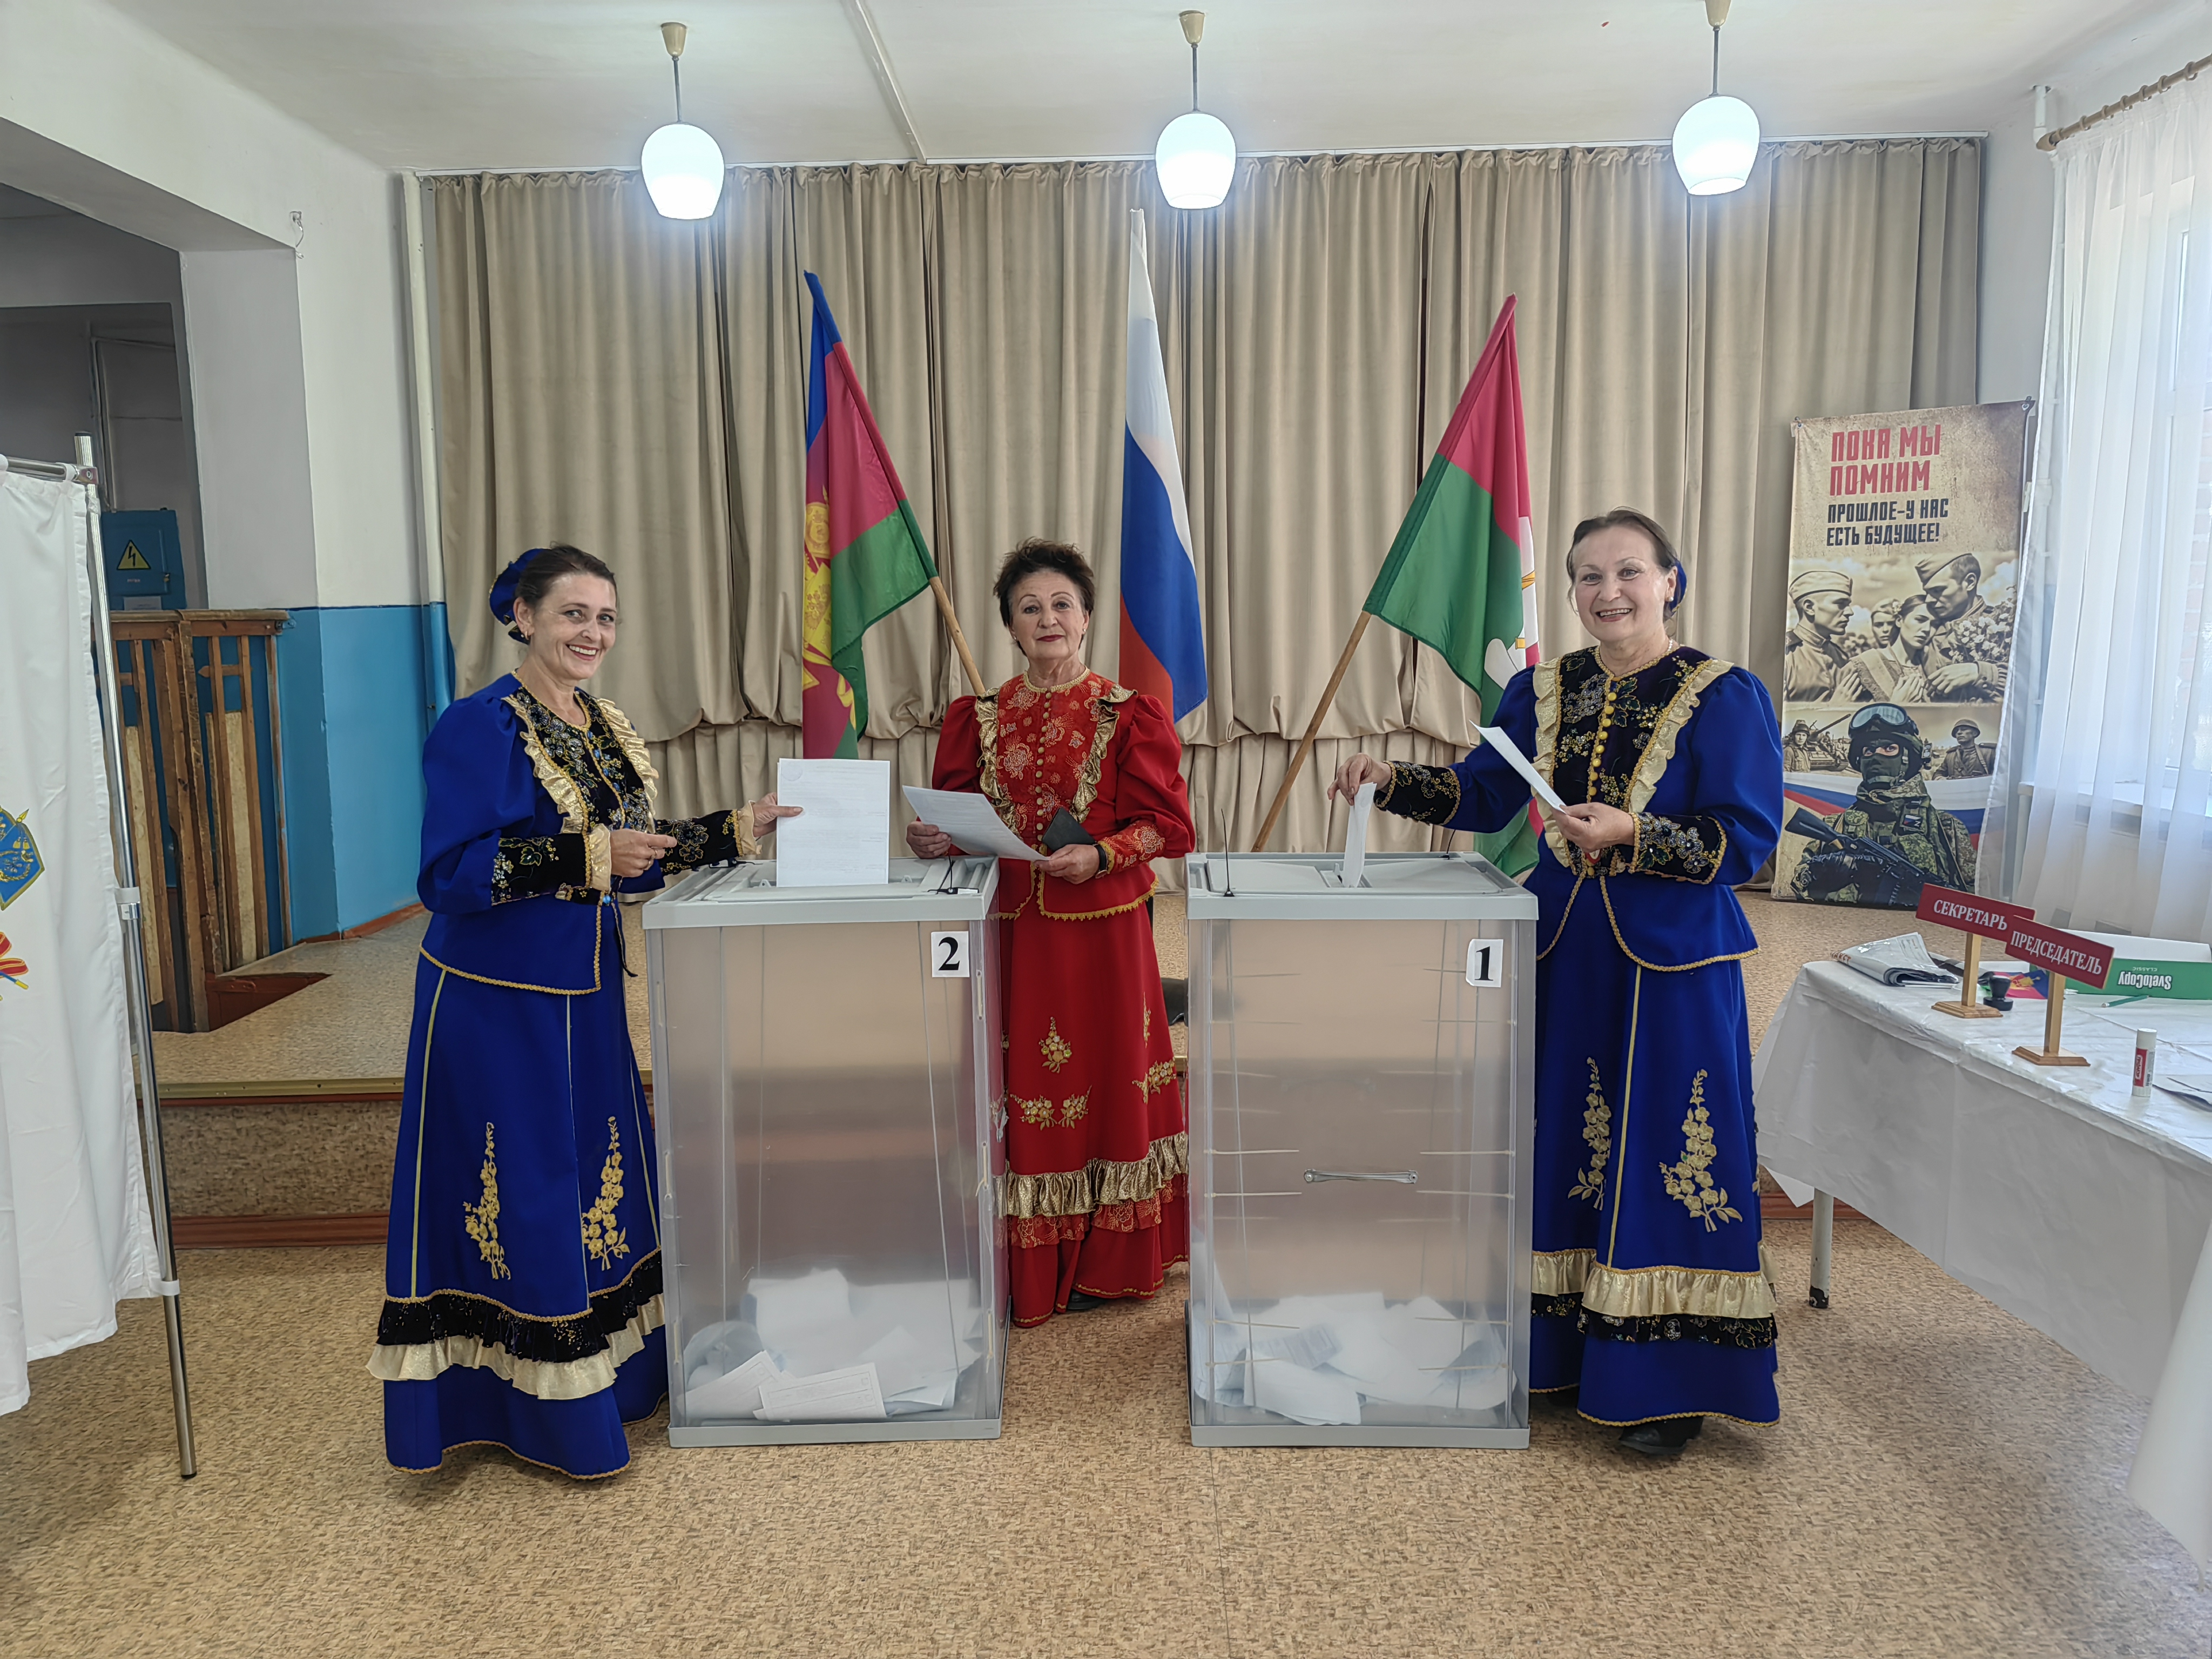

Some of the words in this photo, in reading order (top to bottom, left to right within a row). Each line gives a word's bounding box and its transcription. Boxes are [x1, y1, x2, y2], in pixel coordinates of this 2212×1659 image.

[1831, 428, 1890, 462] ПОКА
[1899, 424, 1941, 457] МЫ
[1830, 460, 1930, 496] ПОМНИМ
[1920, 498, 1948, 519] НАС
[1826, 526, 1859, 547] ЕСТЬ
[1865, 523, 1940, 545] БУДУЩЕЕ!
[1933, 899, 2008, 931] СЕКРЕТАРЬ
[938, 936, 960, 970] 2
[1474, 946, 1494, 981] 1
[2010, 930, 2102, 975] ПРЕДСЕДАТЕЛЬ
[2117, 971, 2172, 990] SvetoCopy
